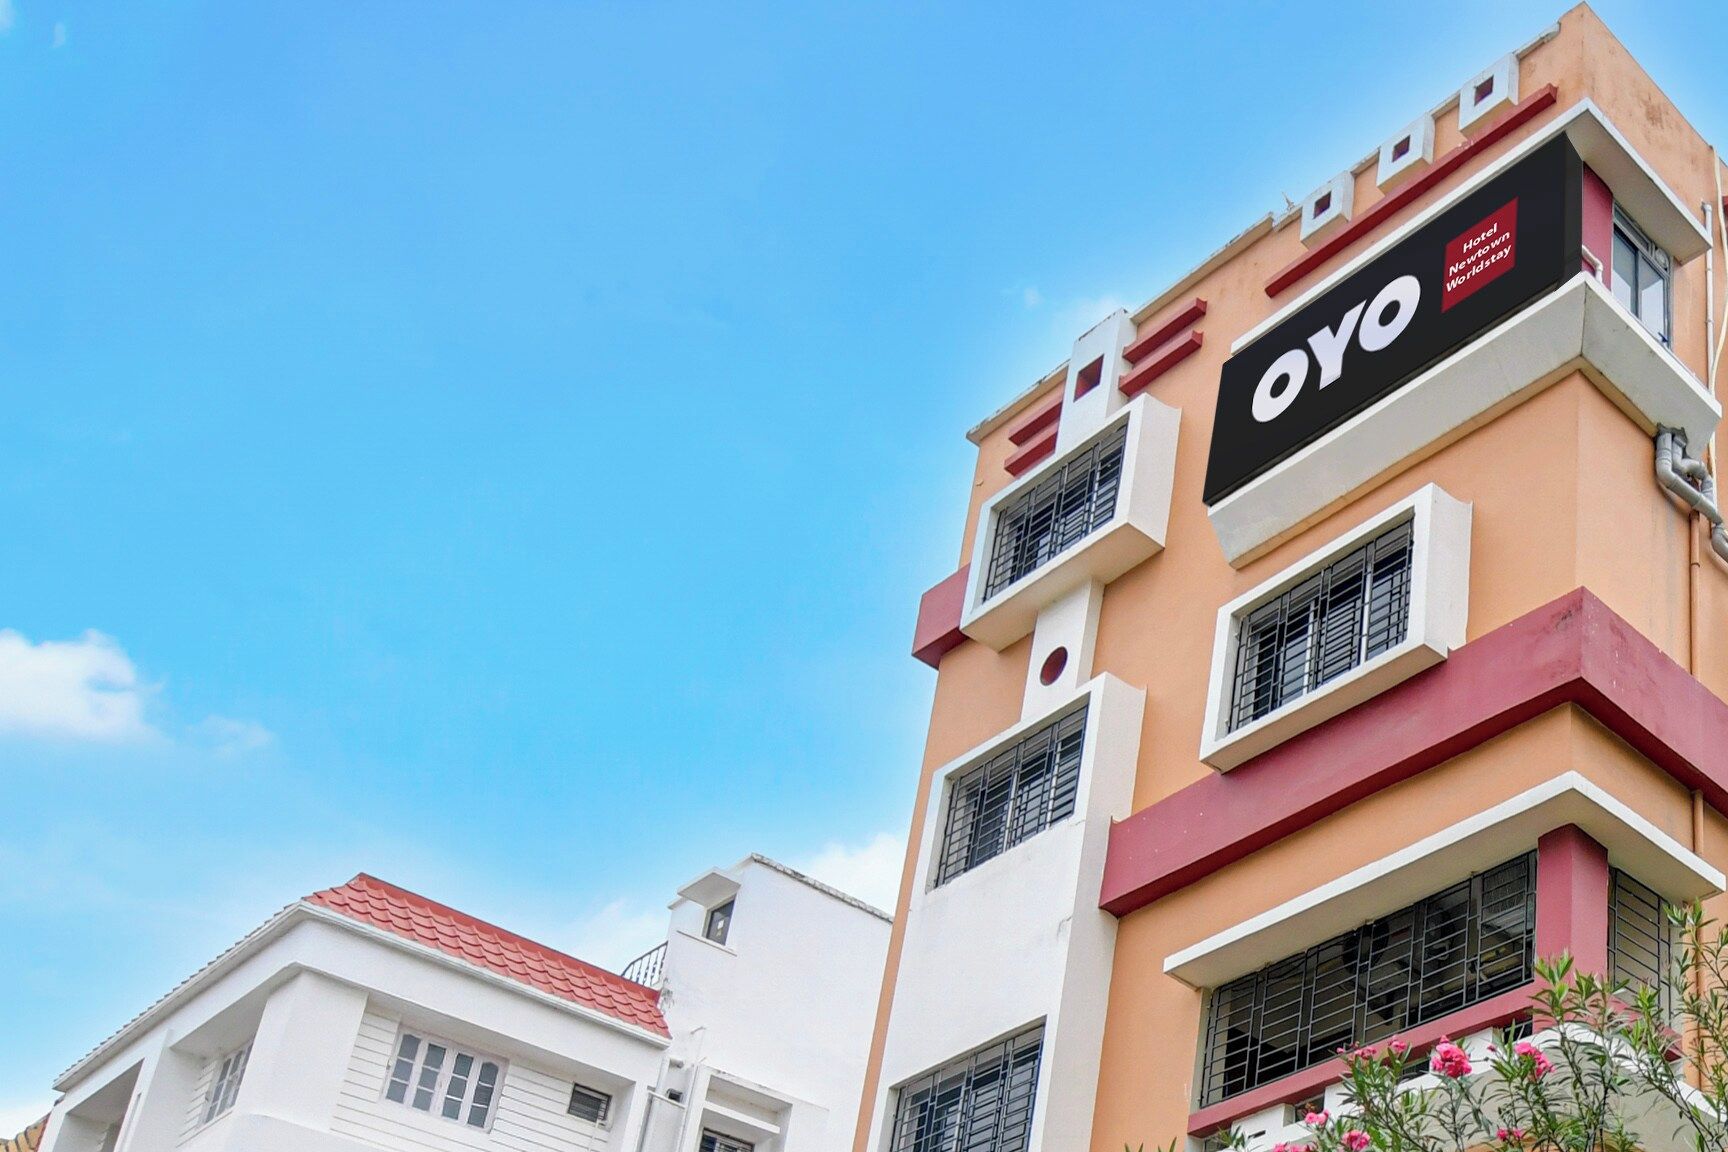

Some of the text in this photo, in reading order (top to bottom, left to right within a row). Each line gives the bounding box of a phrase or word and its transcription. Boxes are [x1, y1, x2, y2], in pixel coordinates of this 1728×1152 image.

[1449, 232, 1510, 276] Newtown
[1463, 222, 1498, 253] Hotel
[1446, 245, 1512, 292] Worldstay
[1252, 275, 1421, 423] OYO
